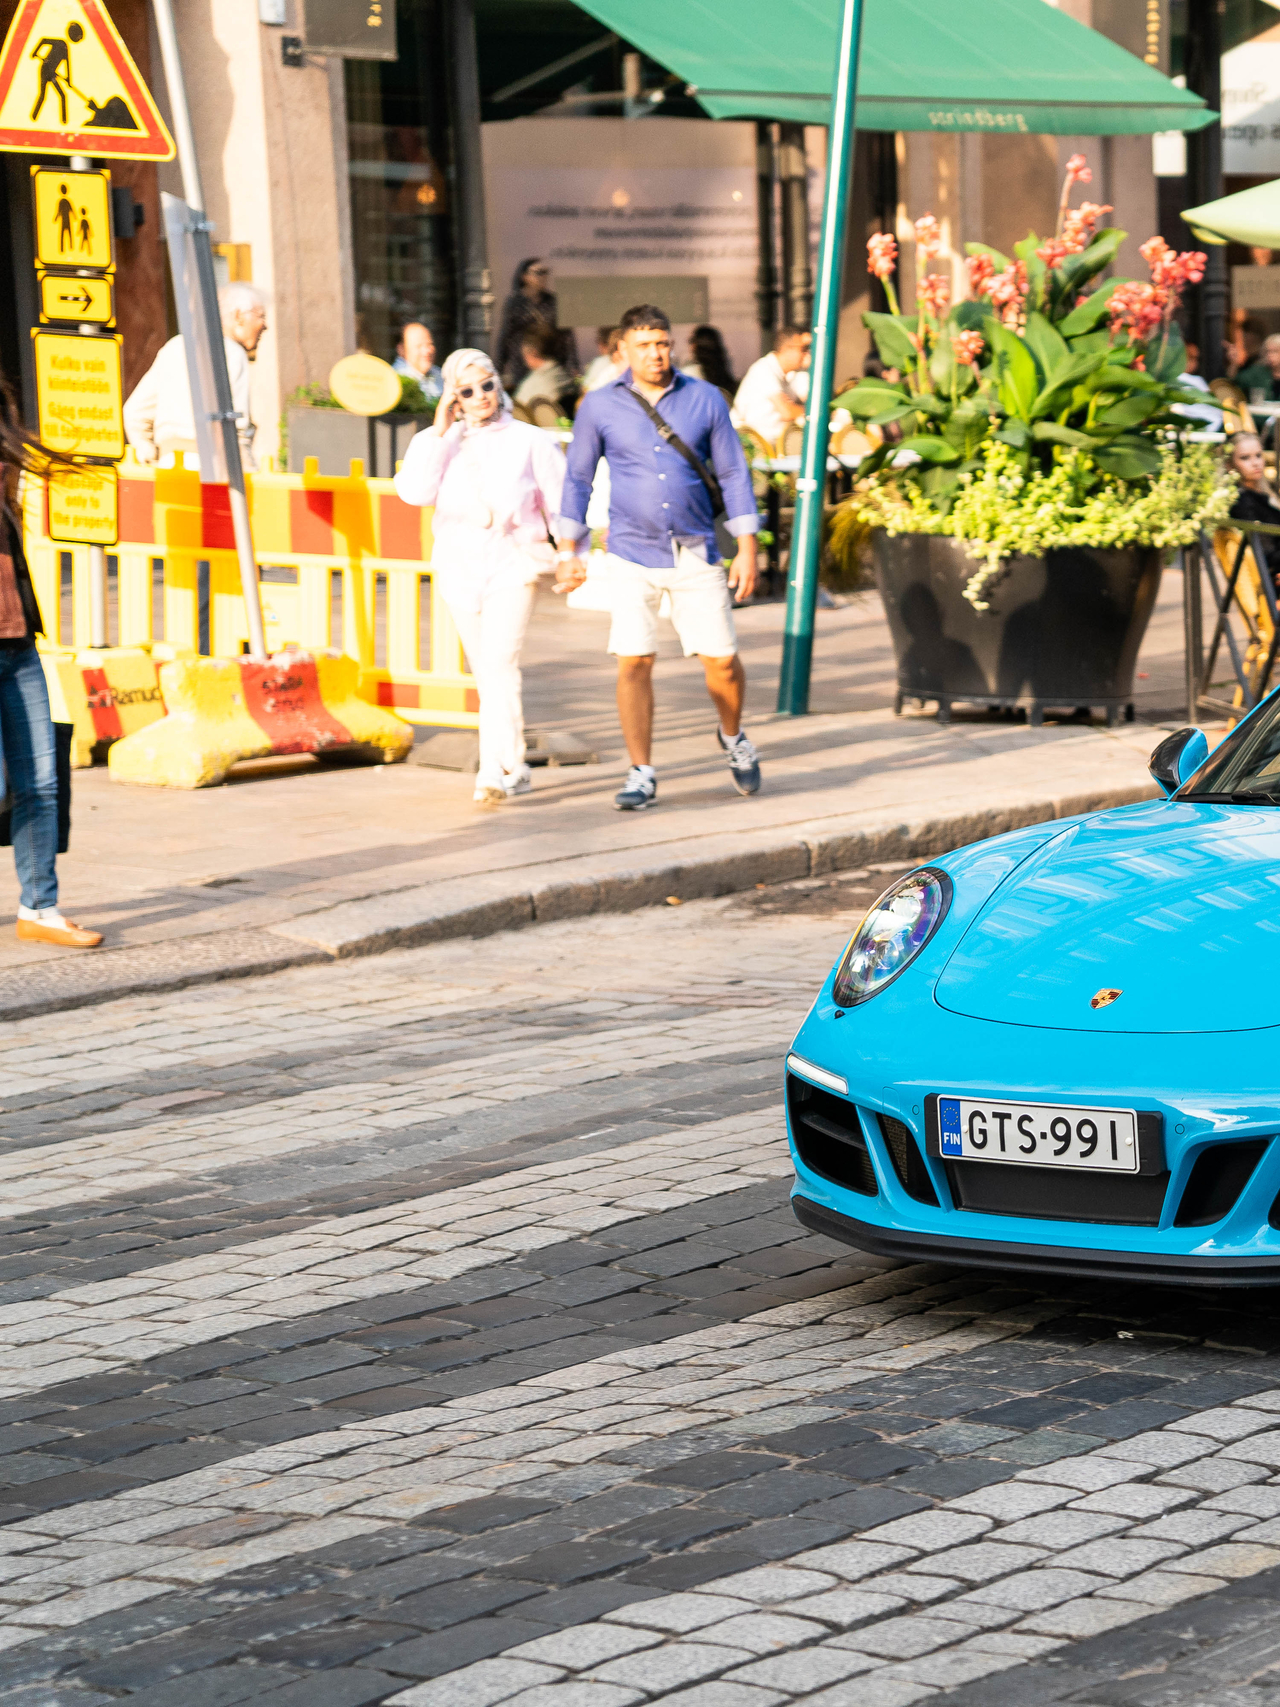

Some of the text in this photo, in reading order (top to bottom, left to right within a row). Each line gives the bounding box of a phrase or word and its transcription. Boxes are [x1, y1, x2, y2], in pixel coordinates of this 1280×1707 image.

[50, 354, 106, 373] Kulku vain
[77, 404, 114, 421] endast
[943, 1110, 1118, 1160] FIN GTS-991
